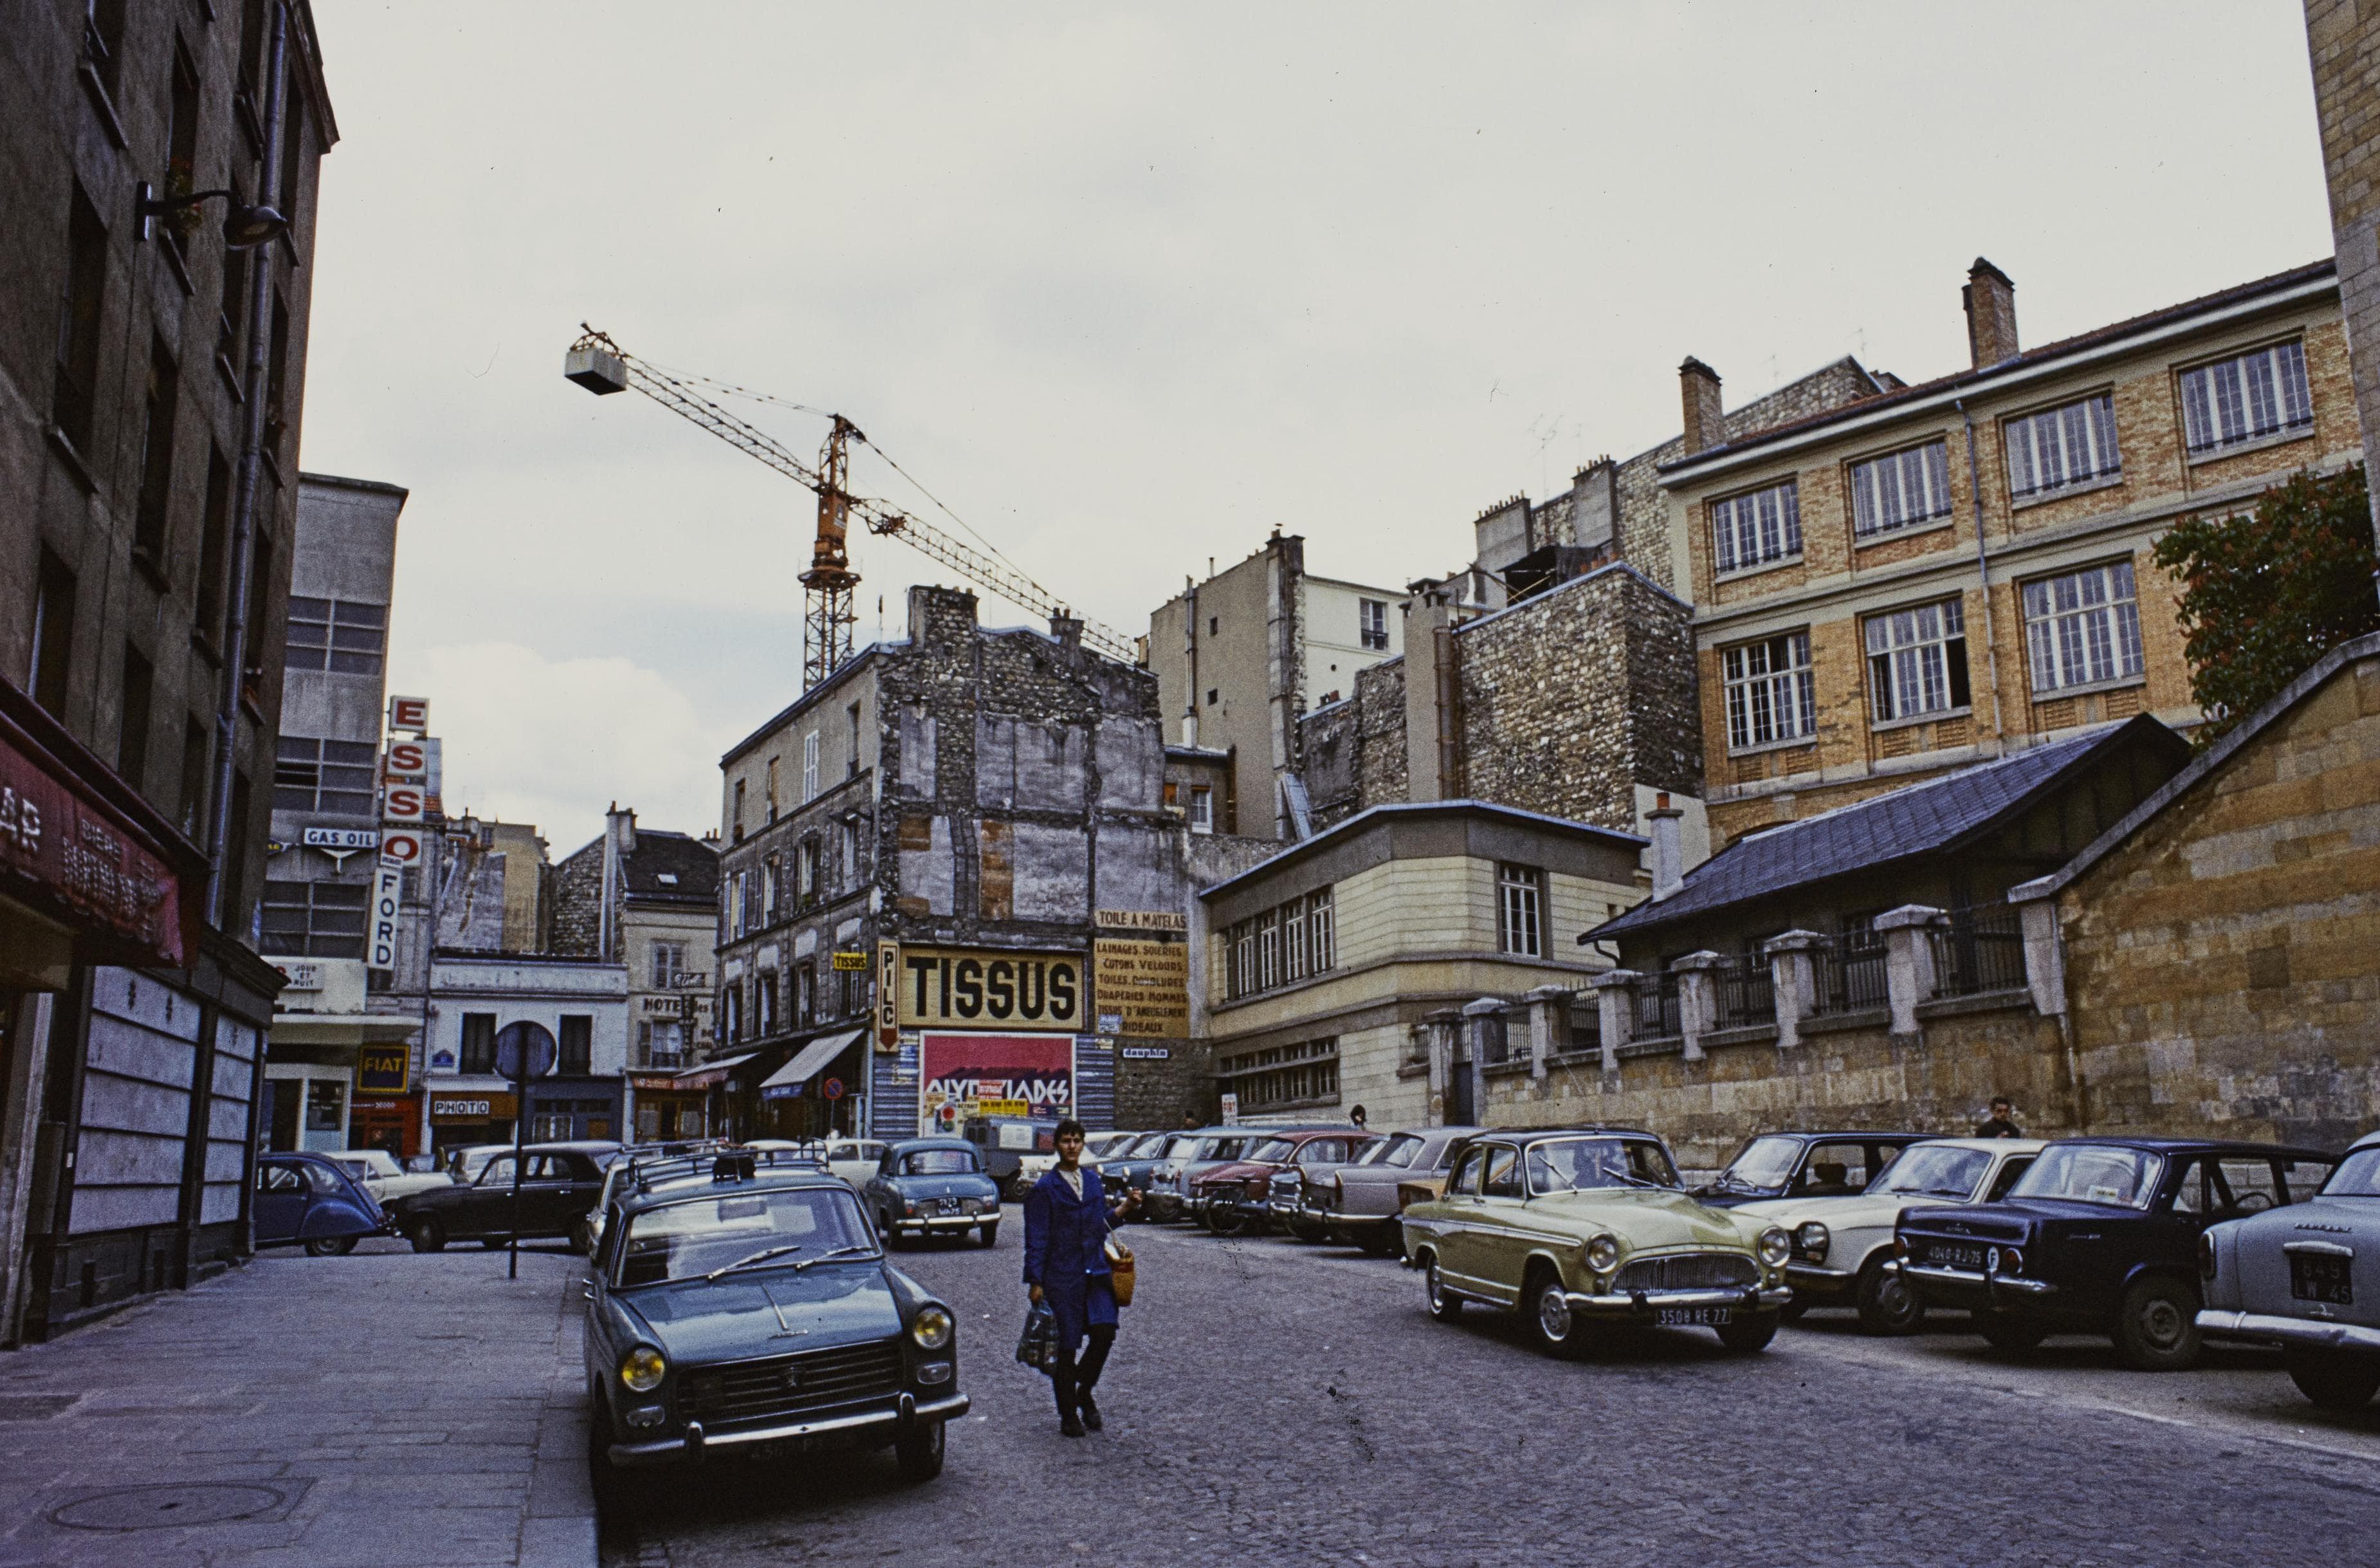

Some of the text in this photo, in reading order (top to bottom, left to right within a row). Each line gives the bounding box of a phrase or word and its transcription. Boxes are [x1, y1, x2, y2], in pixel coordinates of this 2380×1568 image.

[384, 700, 426, 861] ESSO
[307, 831, 372, 845] GAS OIL
[376, 874, 397, 964] FORD
[1099, 911, 1126, 925] TOILE
[1142, 914, 1187, 929] MATELAS
[836, 955, 865, 968] TISSUS
[883, 951, 894, 1024] PILC
[906, 956, 1075, 1020] TISSUS
[643, 998, 688, 1012] HOTE
[365, 1057, 403, 1072] FIAT
[435, 1102, 489, 1112] PHOTO
